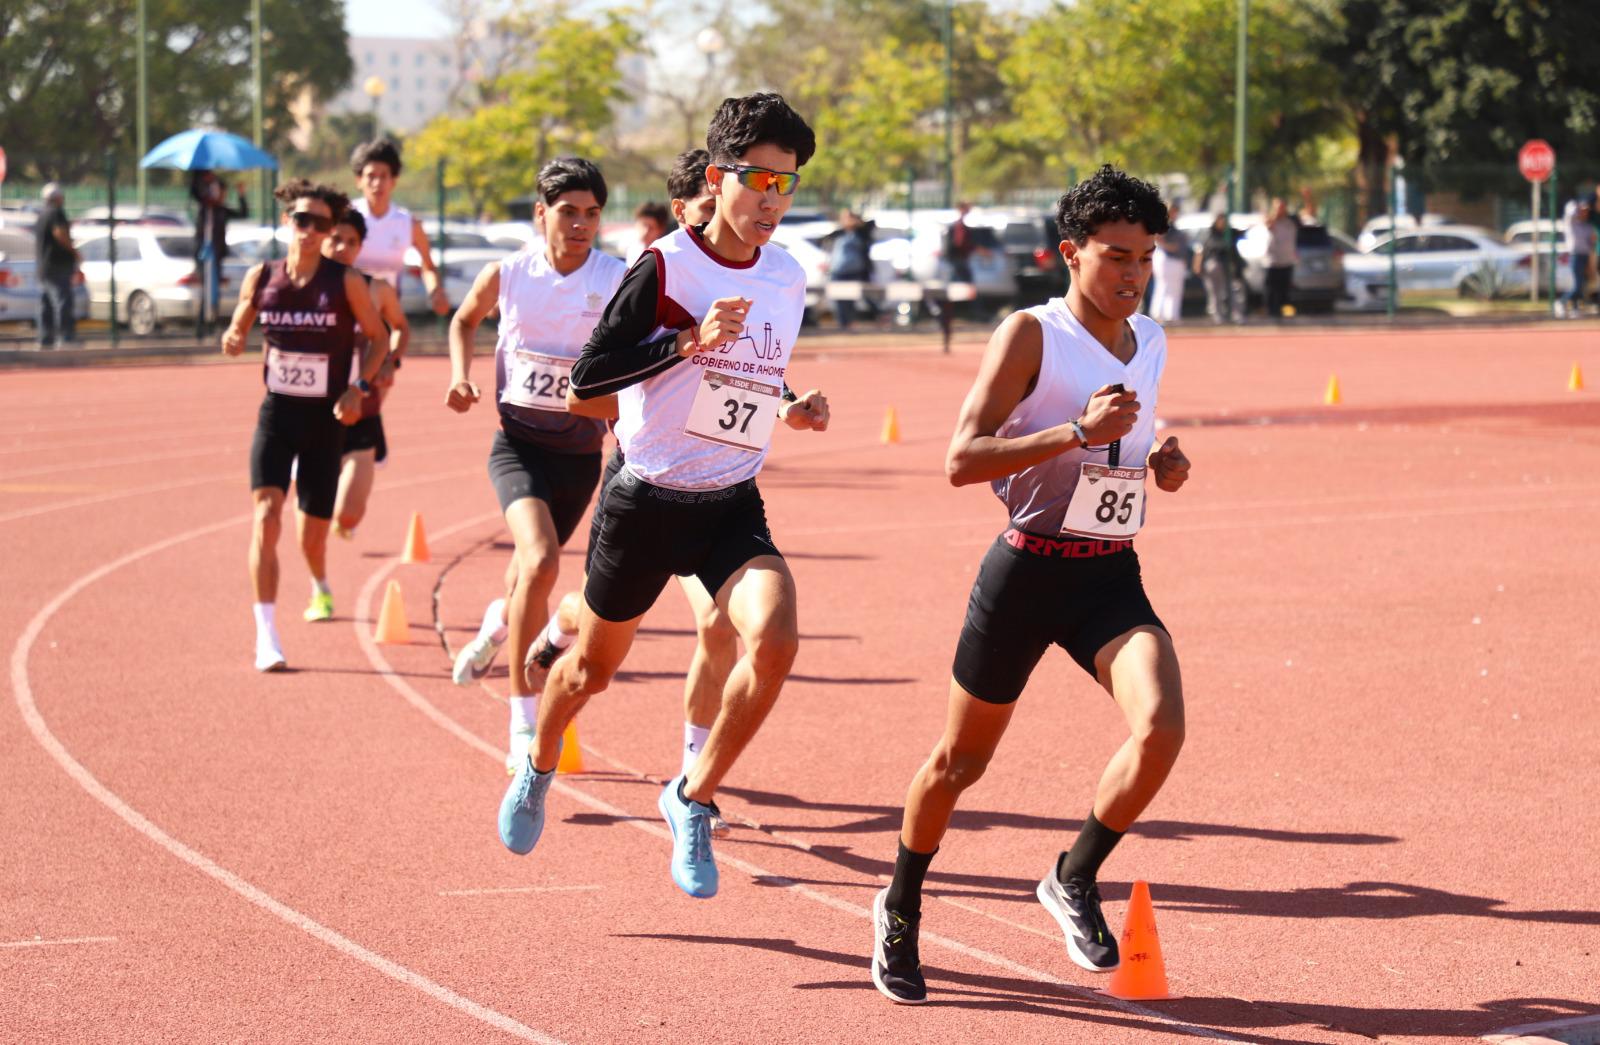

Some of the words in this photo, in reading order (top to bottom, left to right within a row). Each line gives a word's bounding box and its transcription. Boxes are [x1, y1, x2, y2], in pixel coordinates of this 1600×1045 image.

[278, 366, 316, 387] 323
[692, 355, 741, 371] GOBIERNO
[742, 362, 755, 374] DE
[756, 365, 785, 378] AHOME
[522, 371, 570, 399] 428
[718, 399, 758, 434] 37
[1114, 470, 1132, 479] ISDE
[648, 487, 697, 504] NIKE
[699, 487, 737, 504] PRO
[1095, 489, 1136, 525] 85
